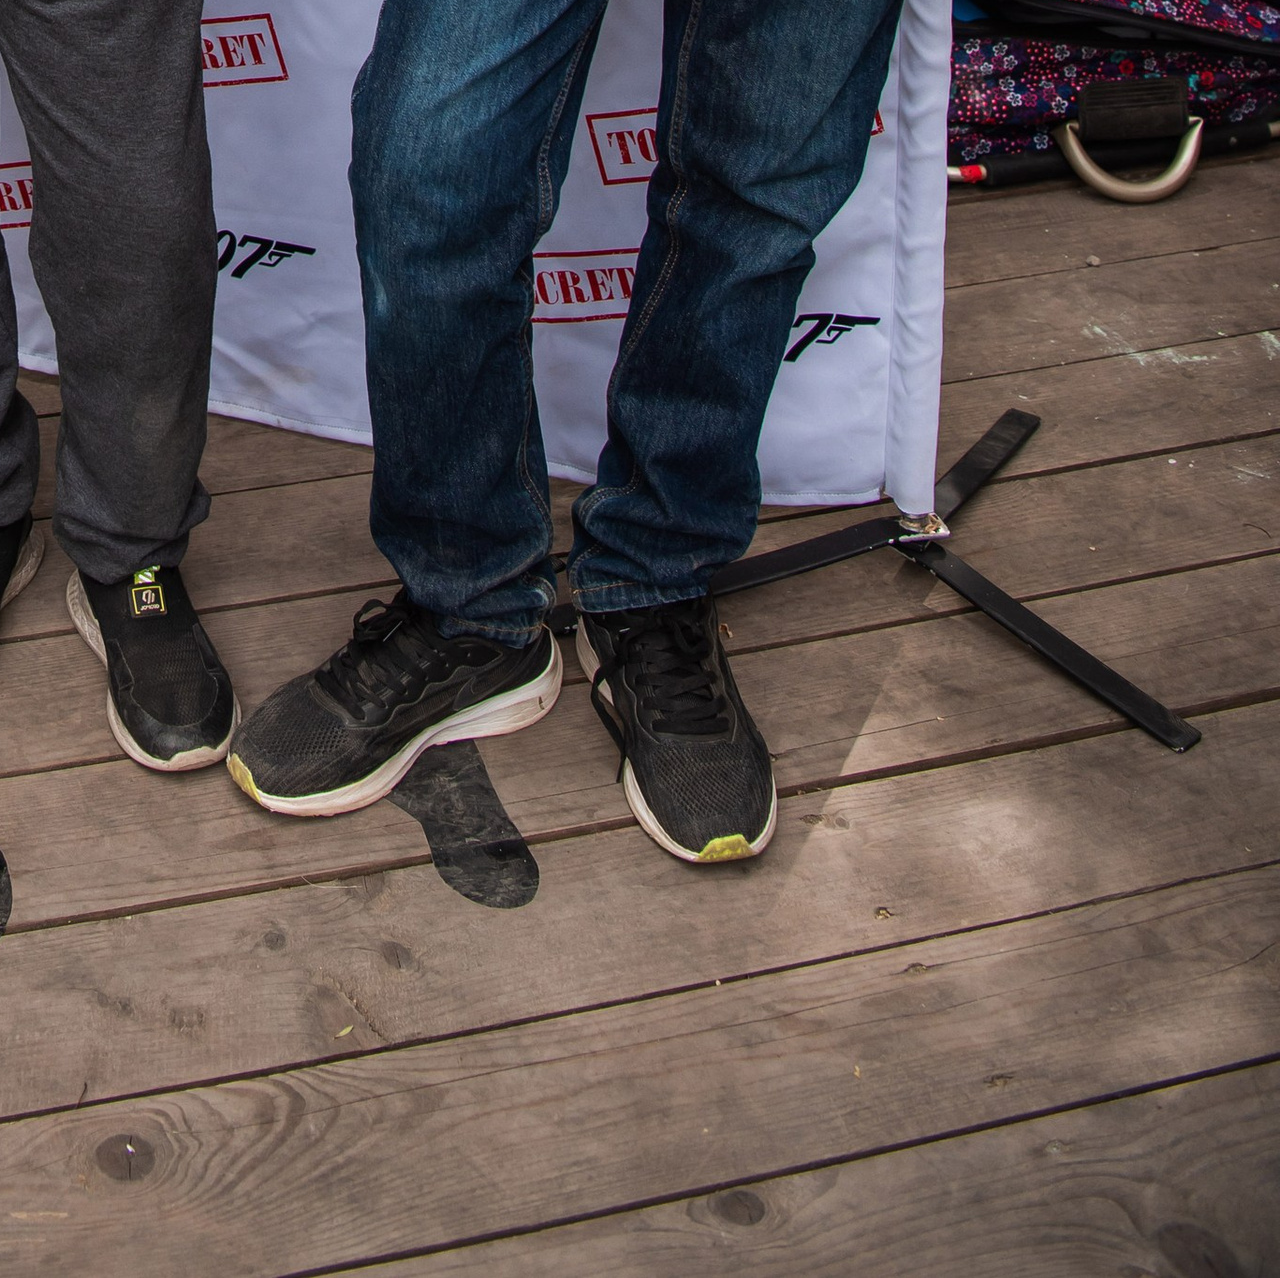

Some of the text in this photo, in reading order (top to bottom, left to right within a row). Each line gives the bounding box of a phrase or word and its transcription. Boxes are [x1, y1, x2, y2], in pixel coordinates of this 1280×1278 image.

[607, 127, 659, 166] TO
[217, 229, 317, 279] 07
[535, 267, 637, 305] CRET
